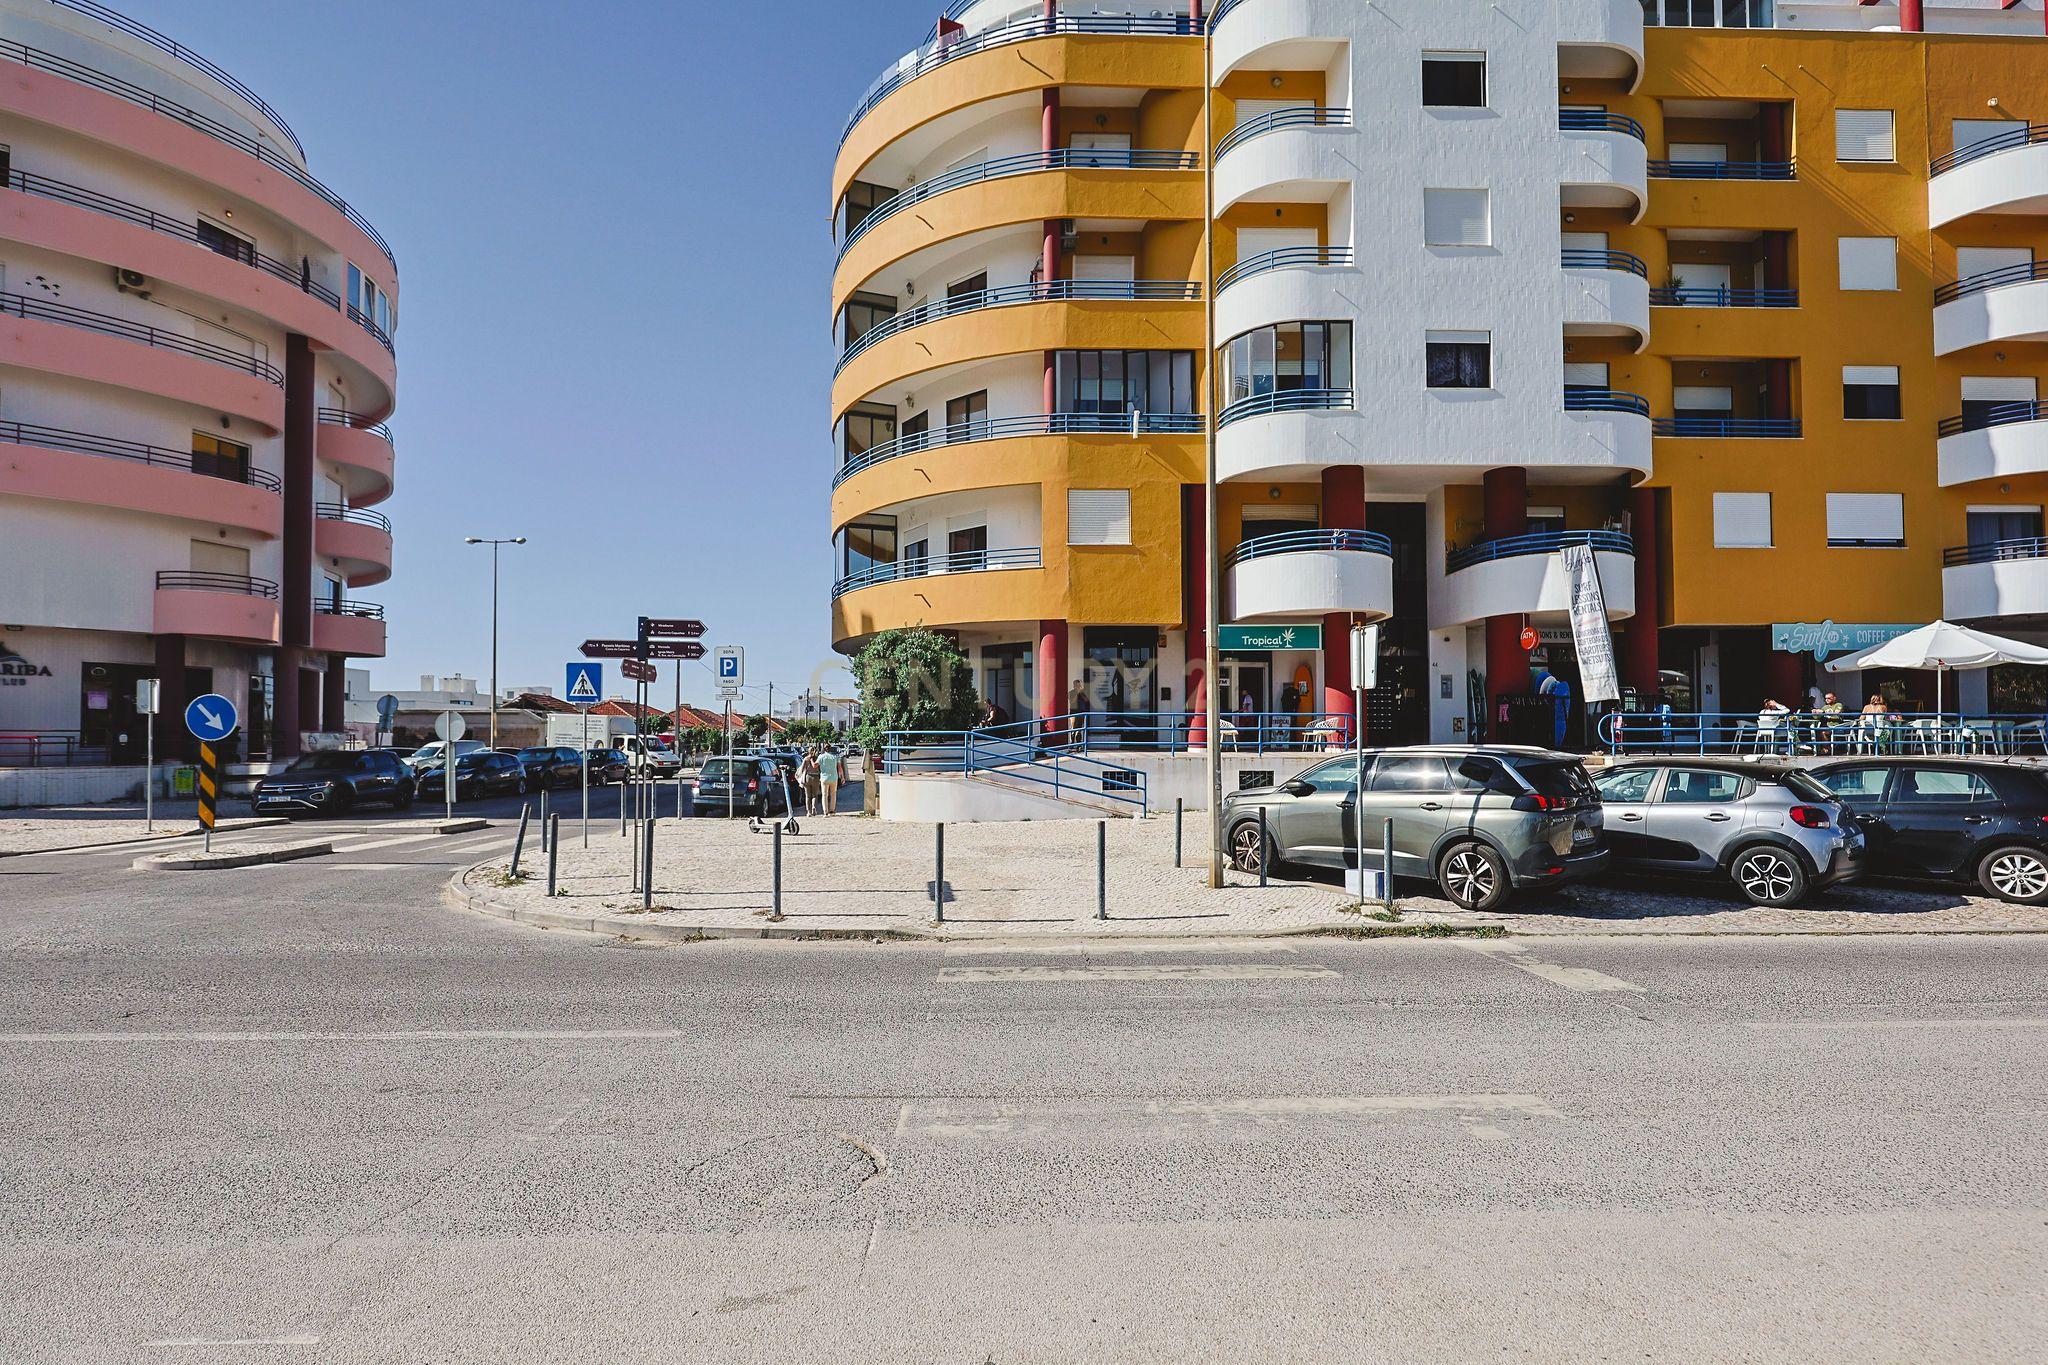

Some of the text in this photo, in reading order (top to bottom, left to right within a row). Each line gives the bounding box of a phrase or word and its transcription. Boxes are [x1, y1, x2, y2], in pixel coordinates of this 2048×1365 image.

[1575, 581, 1592, 594] SURF
[1572, 591, 1600, 606] LESSONS
[1573, 602, 1602, 617] RENTALS
[1242, 635, 1283, 647] Tropical
[1790, 622, 1832, 658] Surf
[1857, 630, 1885, 643] COFFEE
[1580, 653, 1613, 665] WETSUTS
[0, 663, 53, 677] RIBA
[723, 659, 734, 675] P
[0, 678, 26, 686] LUB
